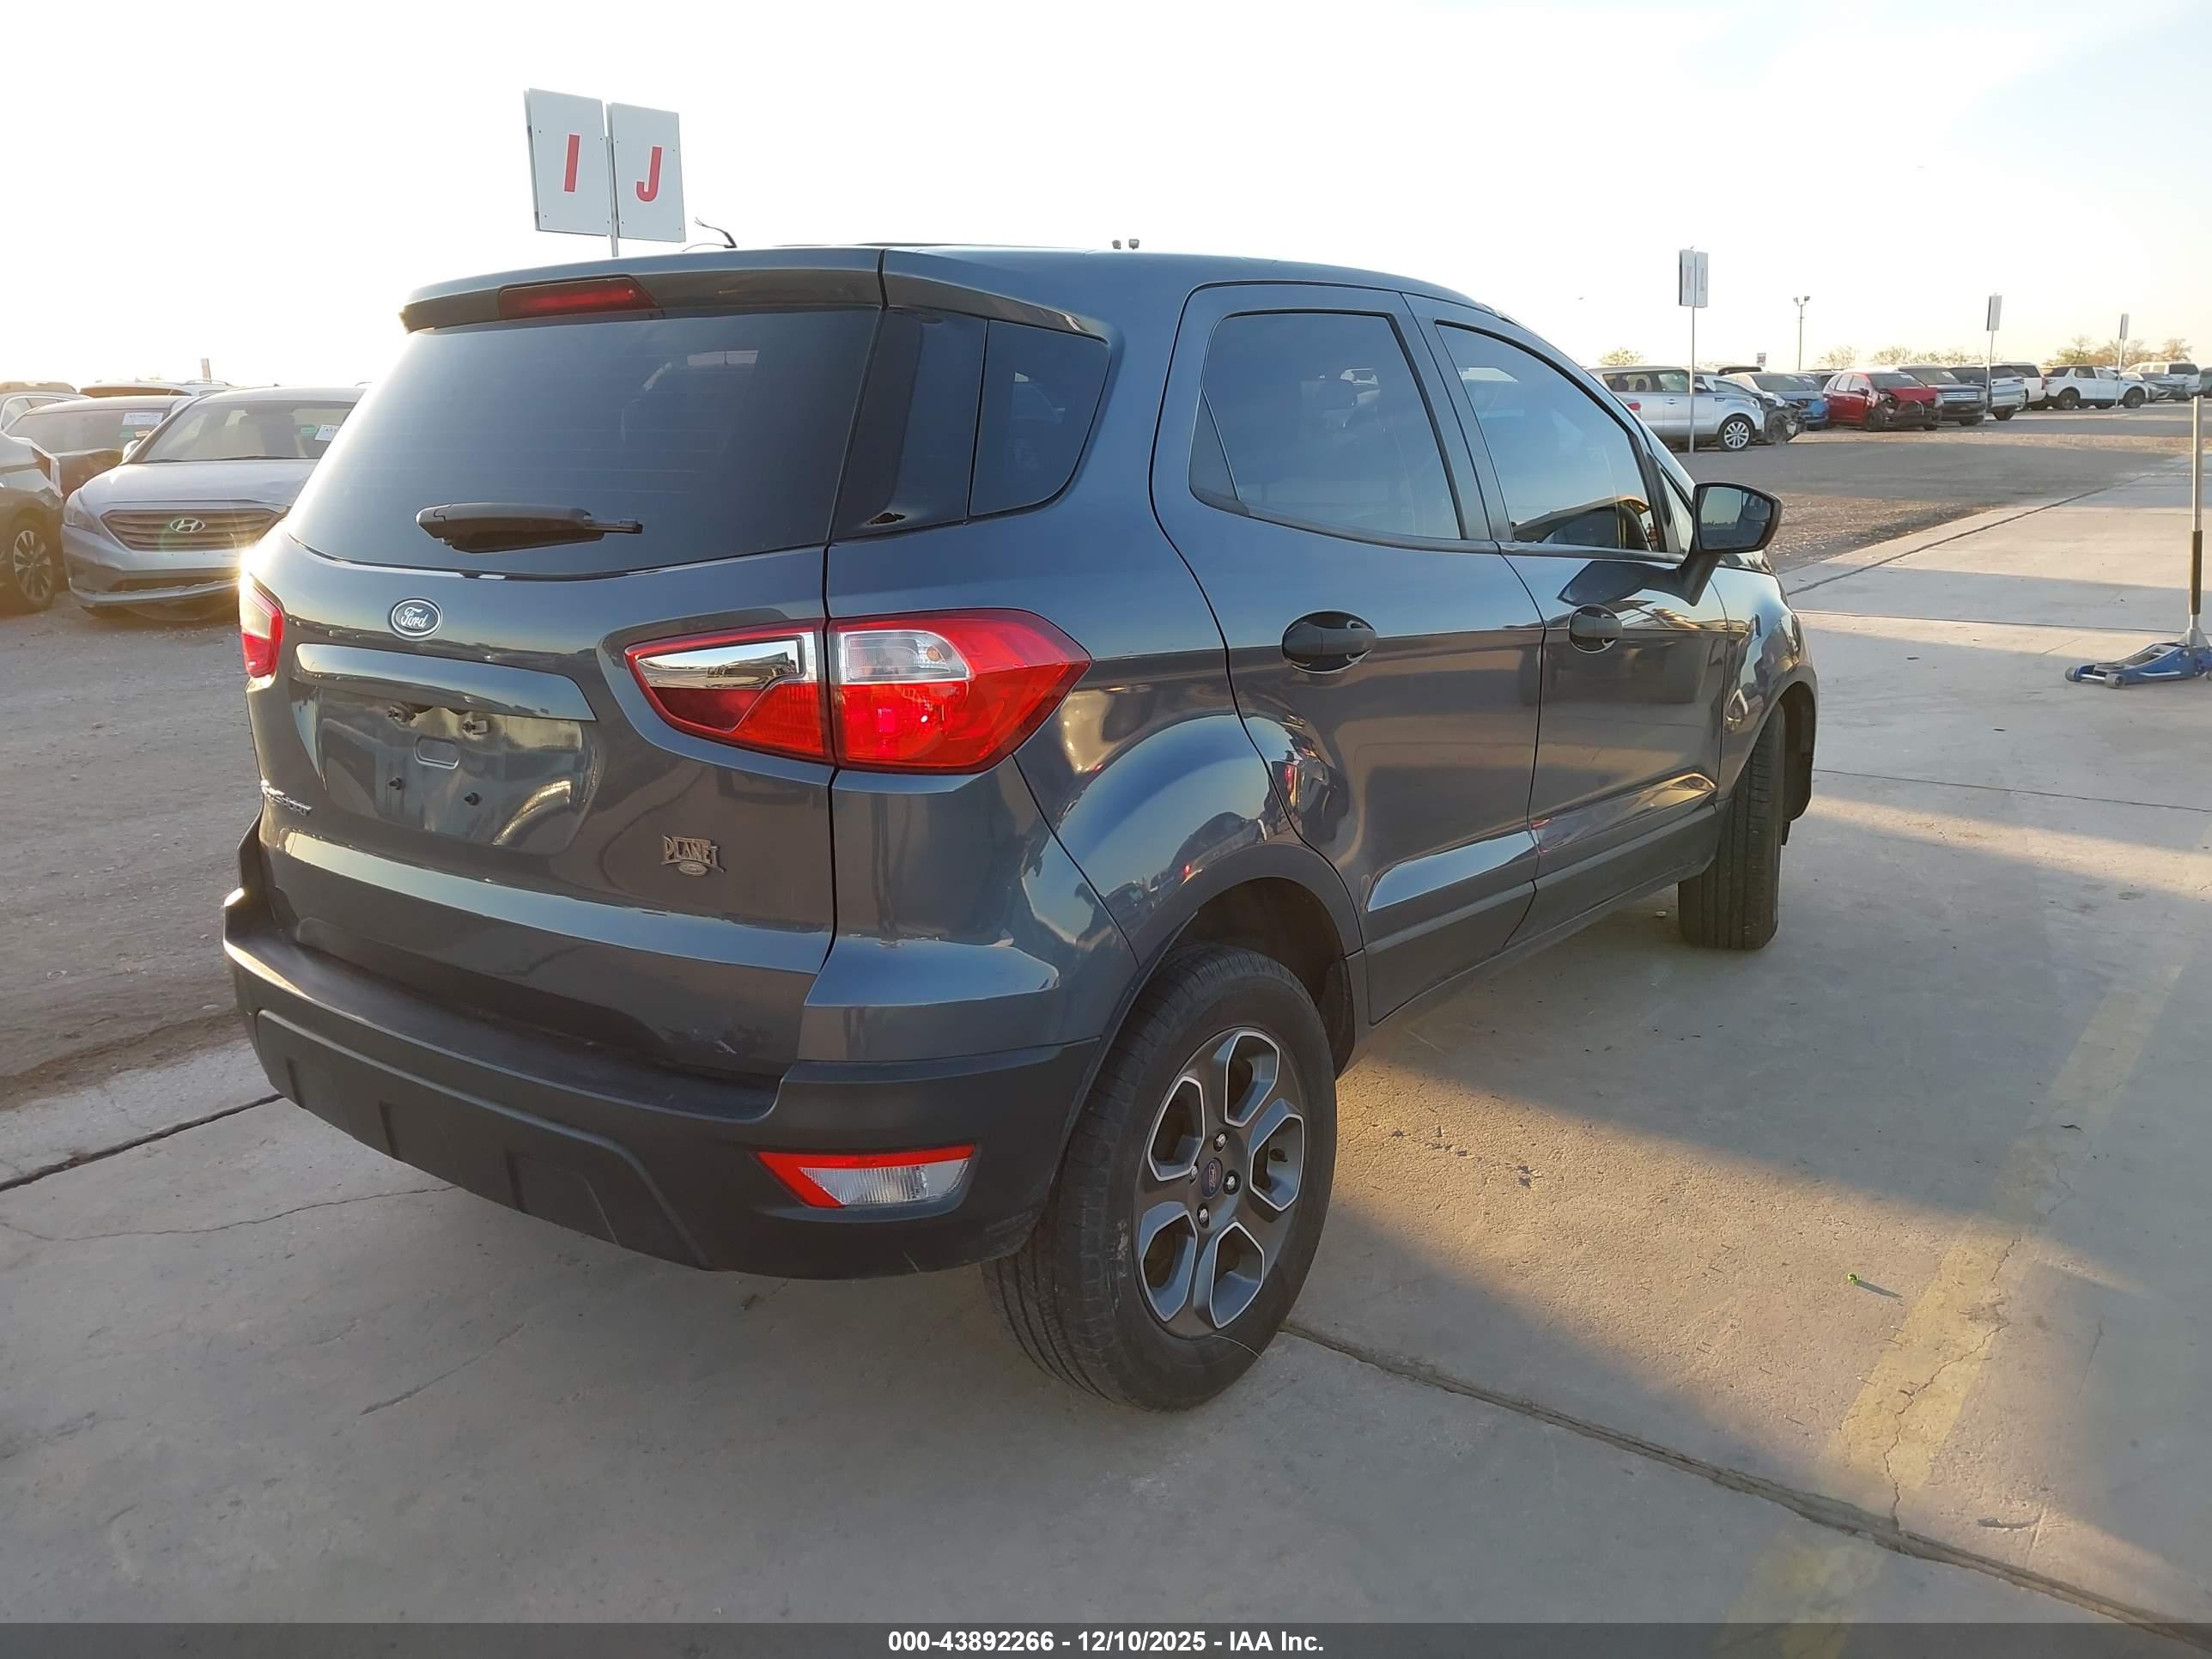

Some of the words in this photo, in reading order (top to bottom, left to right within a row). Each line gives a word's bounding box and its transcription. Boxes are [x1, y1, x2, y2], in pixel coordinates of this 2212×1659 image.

[563, 133, 580, 192] I
[635, 145, 663, 203] J
[400, 606, 429, 629] Ford
[661, 836, 719, 867] PLANET
